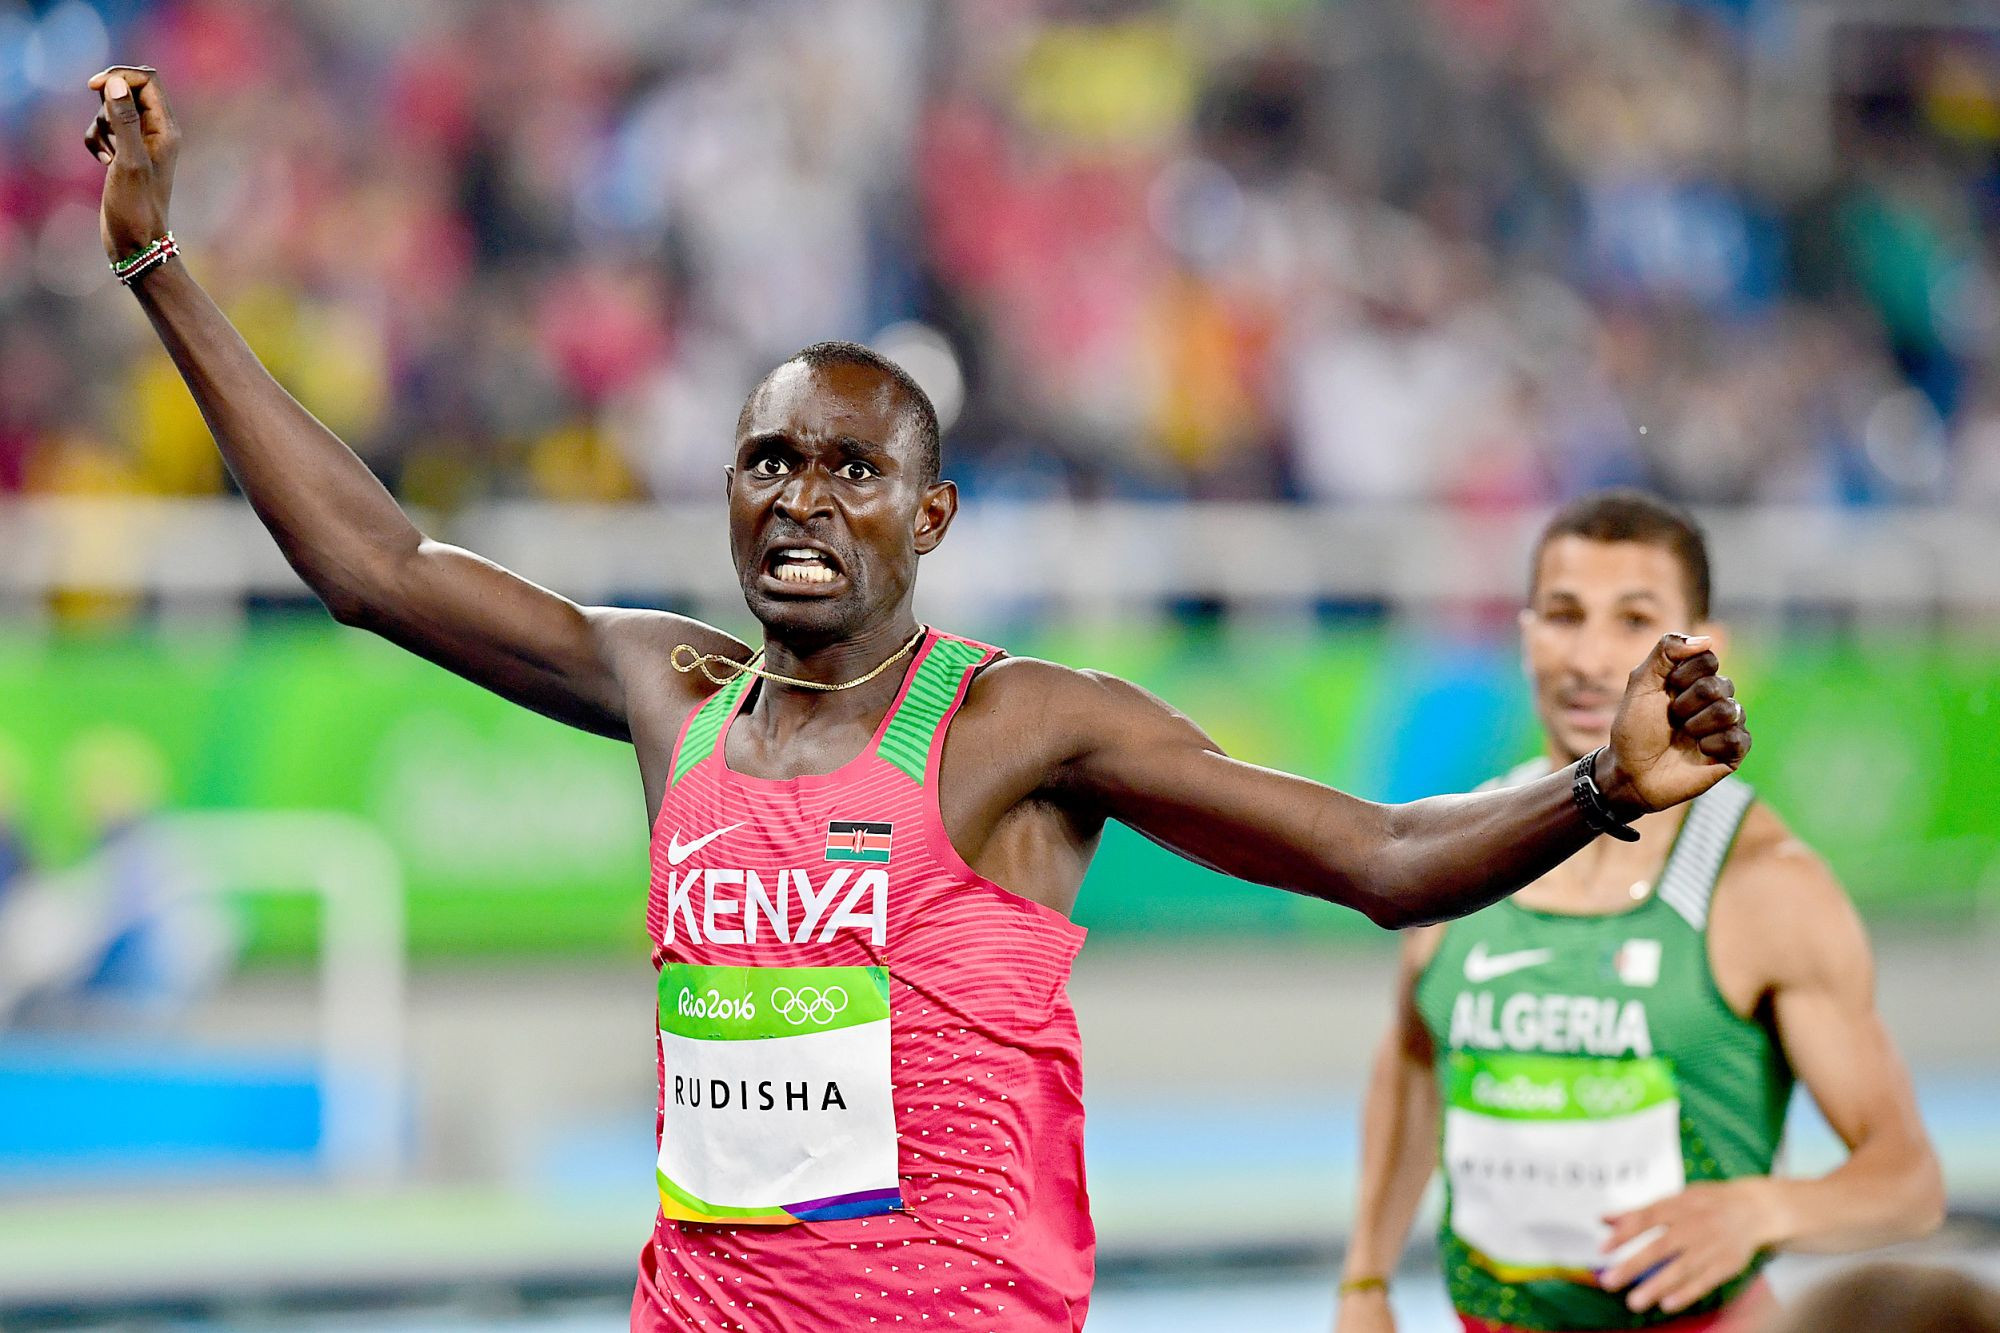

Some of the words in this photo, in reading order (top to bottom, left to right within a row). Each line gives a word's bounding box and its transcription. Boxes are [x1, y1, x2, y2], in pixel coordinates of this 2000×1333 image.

[663, 868, 889, 947] KENYA
[1451, 991, 1652, 1058] ALGERIA
[675, 1075, 848, 1111] RUDISHA
